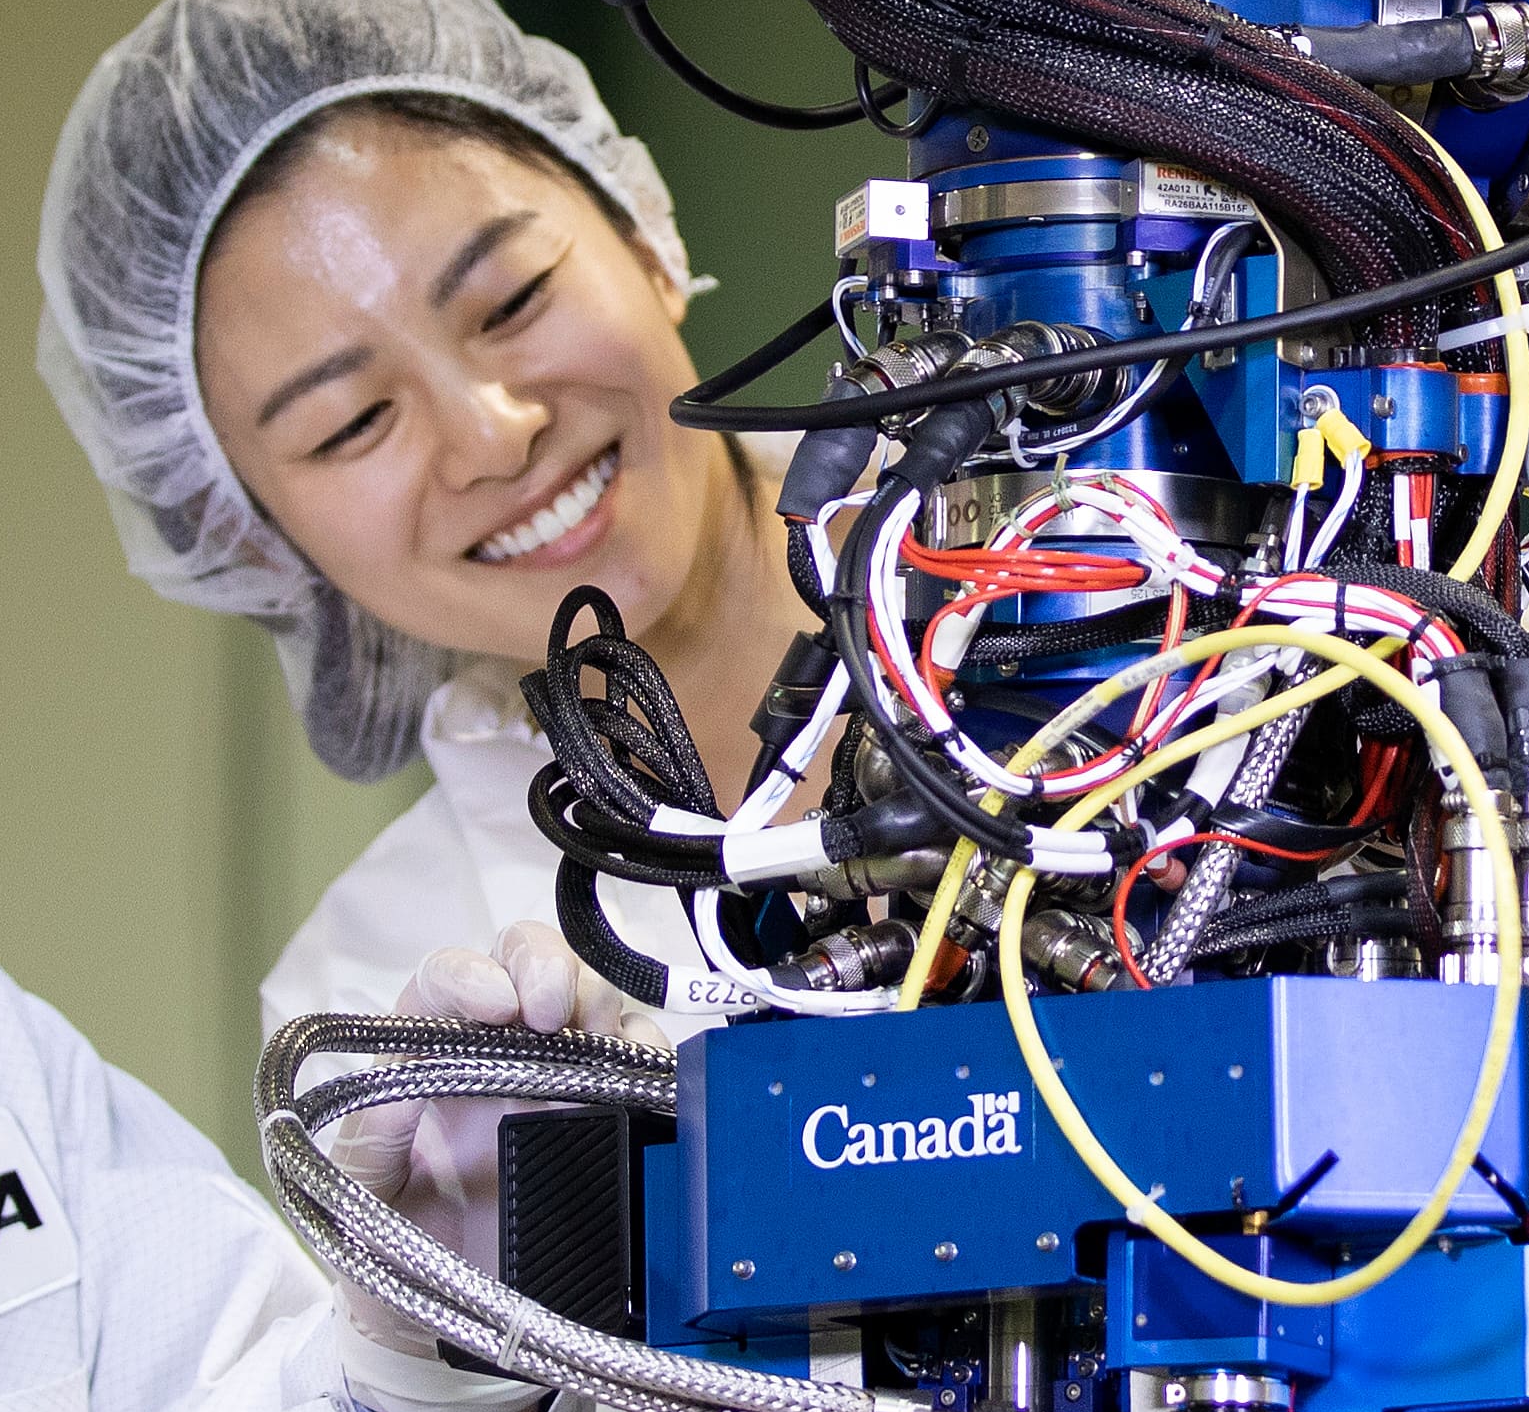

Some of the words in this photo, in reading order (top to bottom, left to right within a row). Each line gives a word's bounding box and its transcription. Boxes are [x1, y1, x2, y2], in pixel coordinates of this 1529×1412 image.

[1156, 166, 1215, 183] RENIS
[1157, 183, 1191, 194] 42A012
[802, 1092, 1022, 1169] Canada
